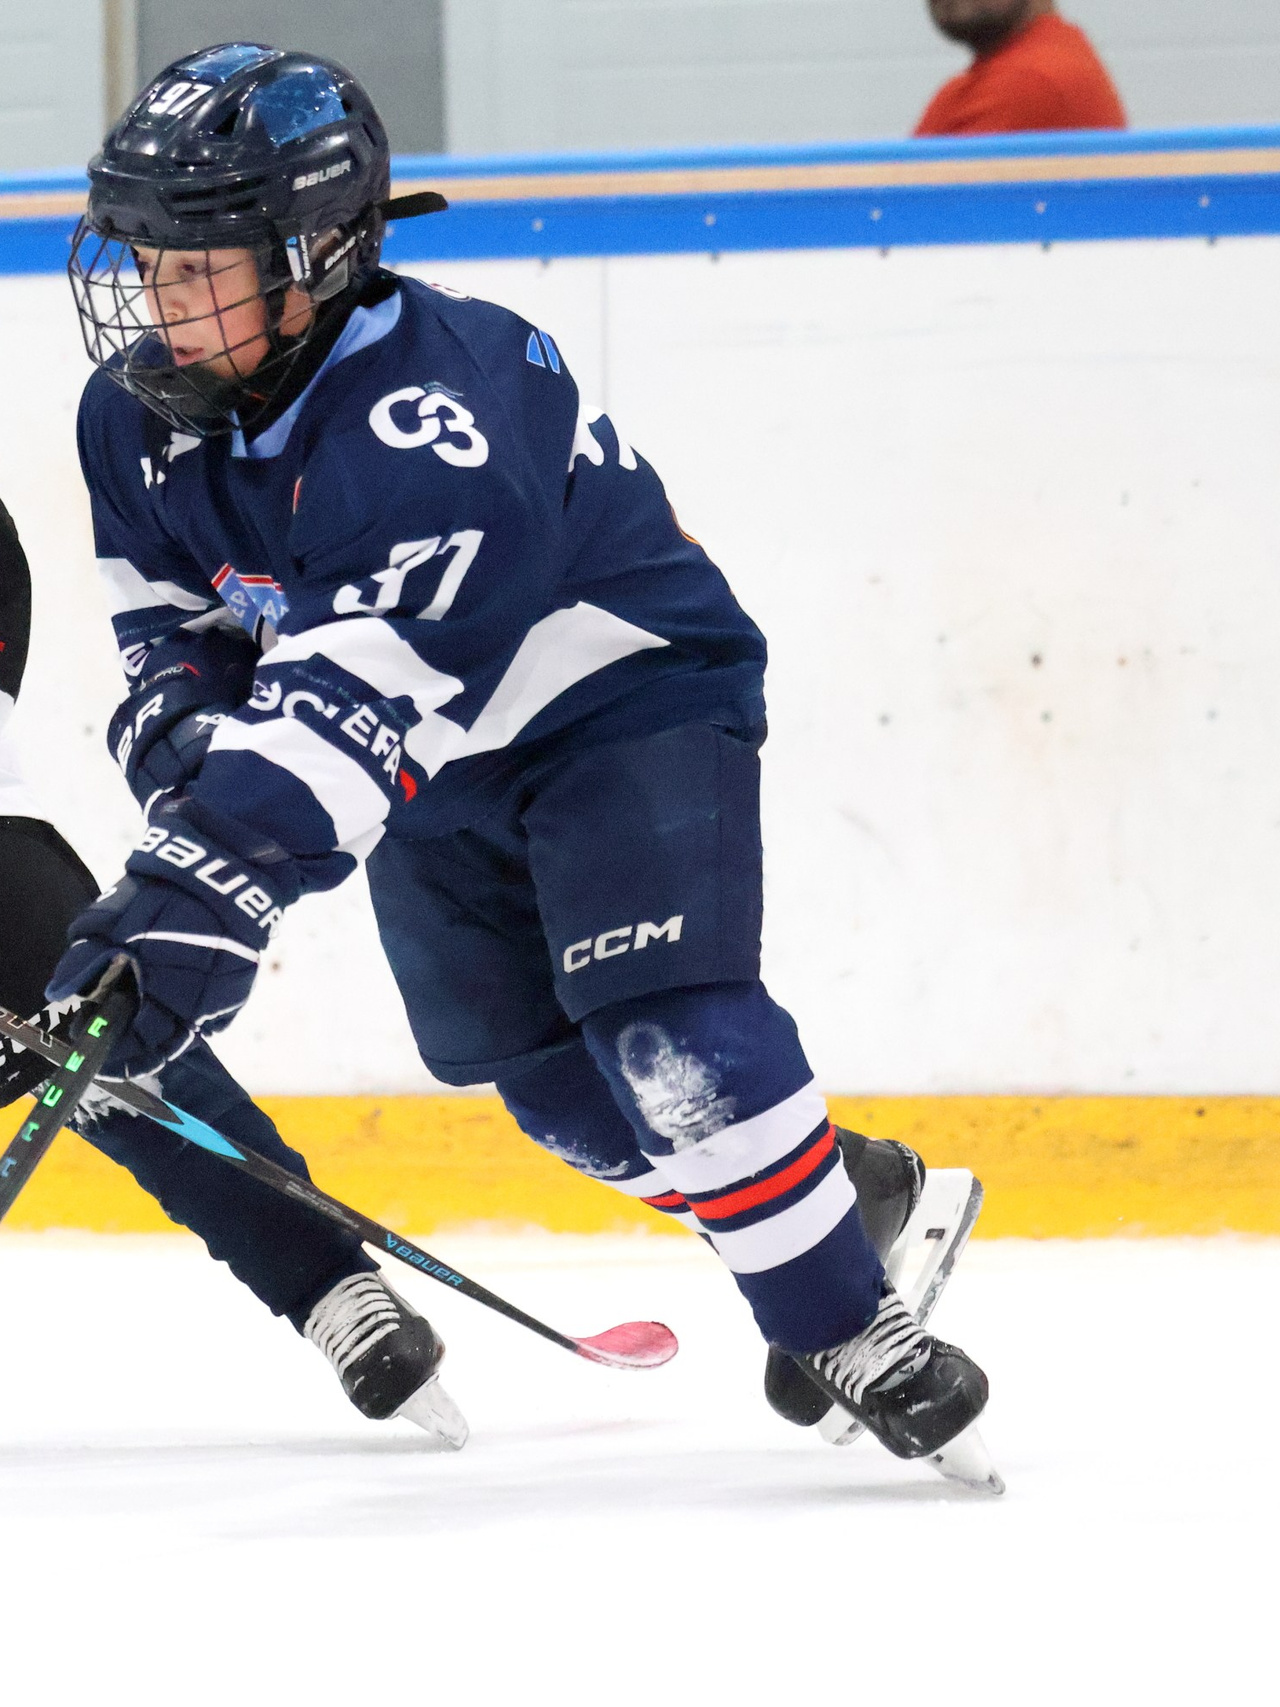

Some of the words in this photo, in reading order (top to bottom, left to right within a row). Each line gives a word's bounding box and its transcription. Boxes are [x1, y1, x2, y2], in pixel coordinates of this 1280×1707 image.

[147, 82, 213, 116] 97
[292, 159, 352, 192] BAUER
[136, 826, 286, 930] BAUER
[563, 914, 685, 975] CCM
[395, 1245, 464, 1287] BAUER
